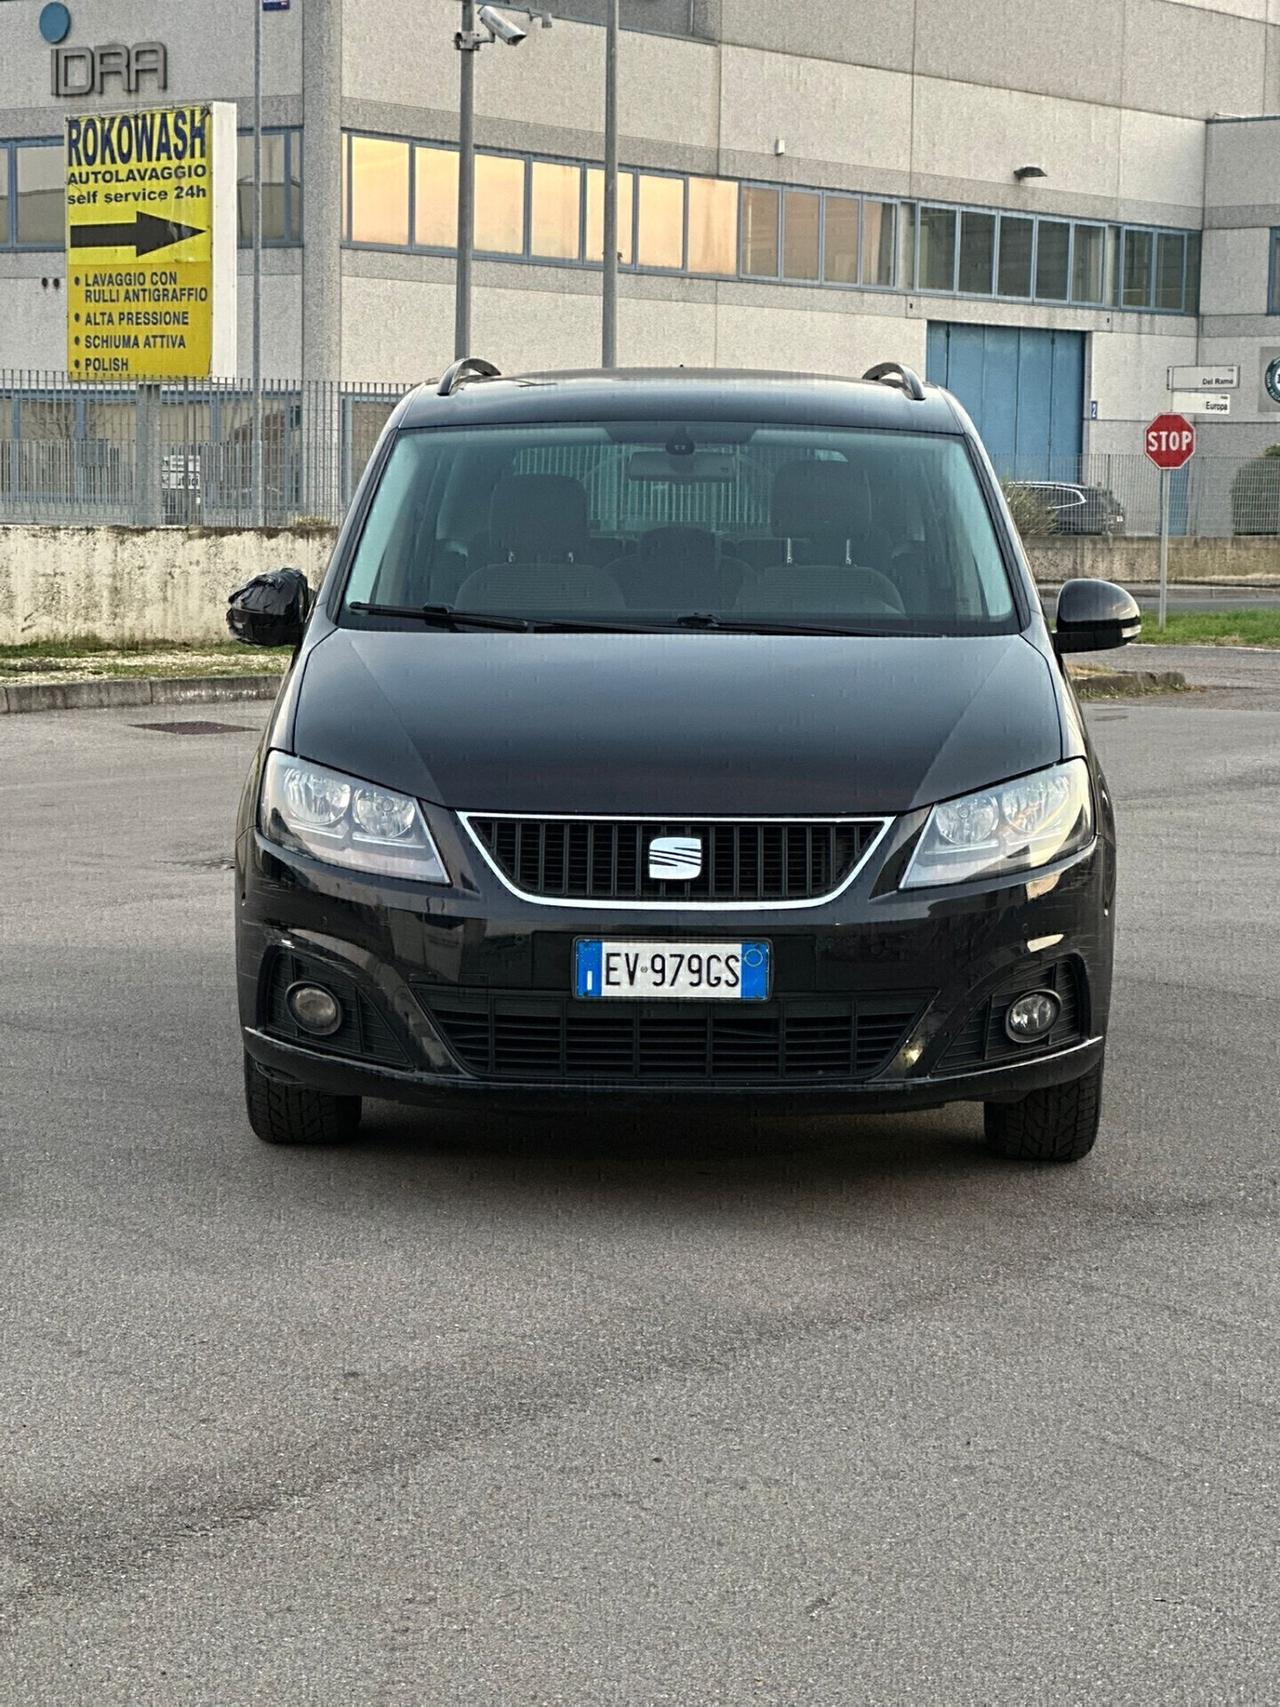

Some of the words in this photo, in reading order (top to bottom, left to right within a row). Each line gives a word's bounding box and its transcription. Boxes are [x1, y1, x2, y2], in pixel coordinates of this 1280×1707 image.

[51, 41, 168, 97] IDRA
[67, 108, 207, 167] ROKOWASH
[67, 164, 207, 185] AUTOLAVAGGIO
[67, 191, 98, 205] self
[104, 189, 168, 203] service
[174, 185, 207, 200] 24h
[85, 272, 146, 287] LAVAGGIO
[150, 271, 178, 286] CON
[85, 289, 120, 303] RULLI
[123, 287, 208, 302] ANTIGRAFFIO
[85, 312, 115, 326] ALTA
[118, 311, 189, 326] PRESSIONE
[85, 335, 140, 349] SCHIUMA
[143, 334, 186, 349] ATTIVA
[85, 357, 129, 372] POLISH
[1205, 401, 1228, 411] Europa
[1148, 430, 1193, 452] STOP
[605, 952, 640, 987] EV
[650, 953, 741, 988] 979GS
